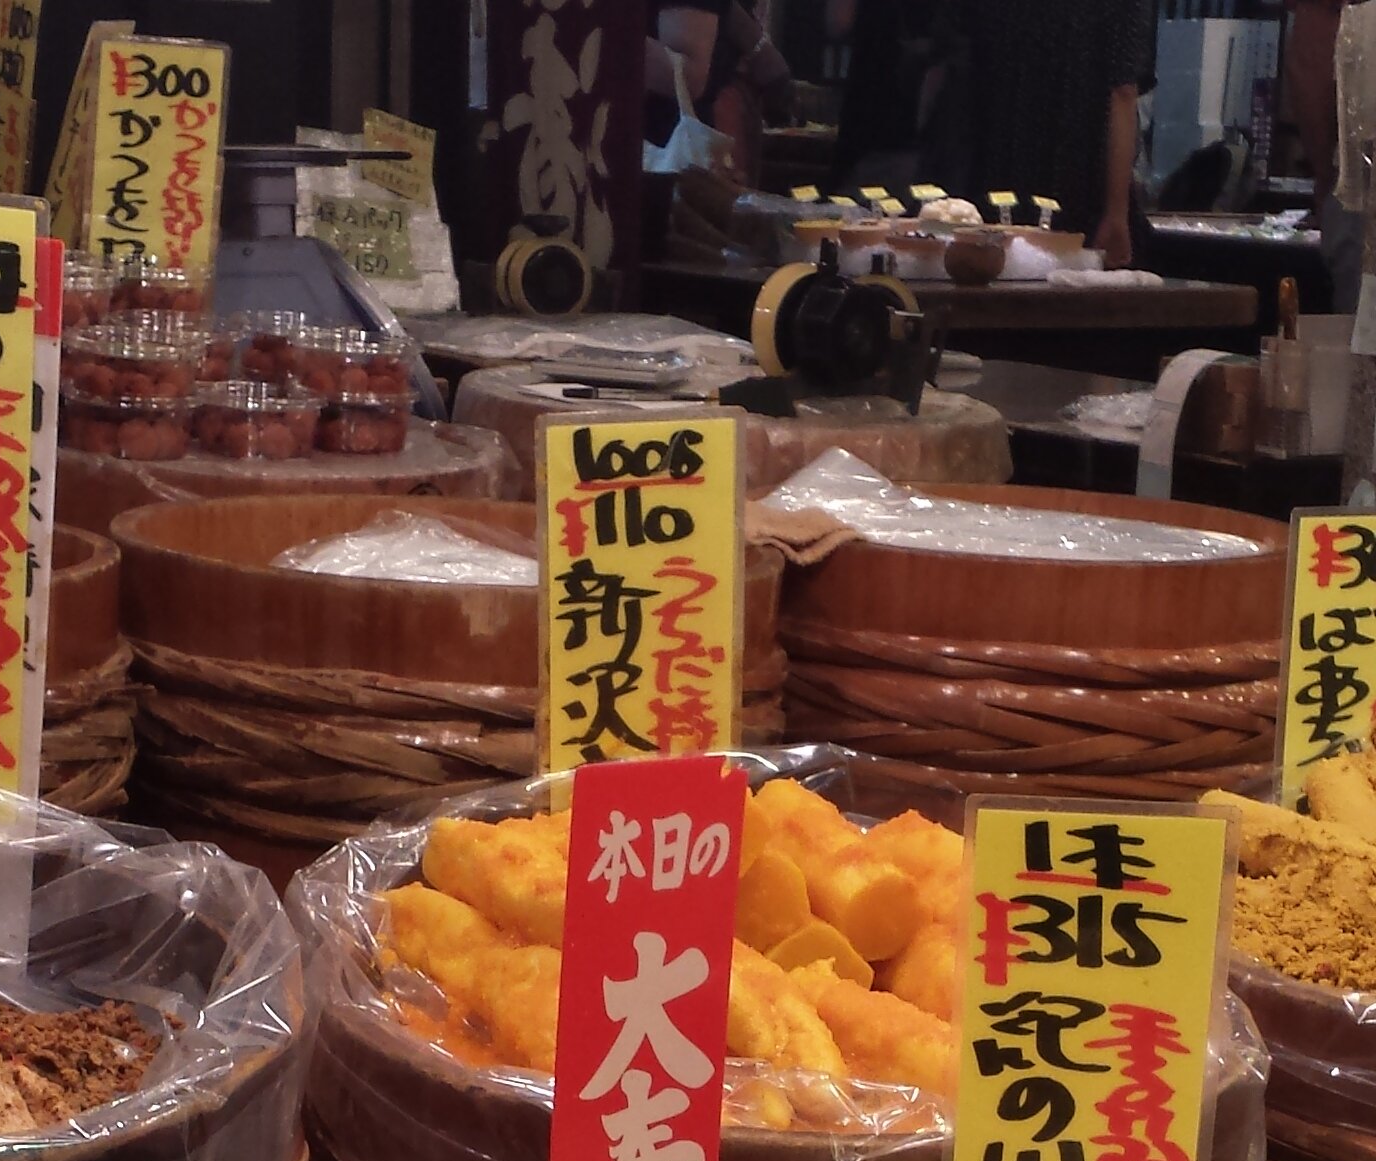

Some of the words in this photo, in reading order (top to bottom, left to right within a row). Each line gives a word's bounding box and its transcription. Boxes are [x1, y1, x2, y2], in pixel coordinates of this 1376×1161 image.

[110, 51, 210, 97] ¥300
[573, 427, 703, 481] 100g
[555, 485, 695, 557] ¥110
[555, 559, 661, 764] 新沢
[588, 810, 730, 903] 本日の
[1025, 821, 1155, 889] 1本
[974, 892, 1187, 986] ¥315
